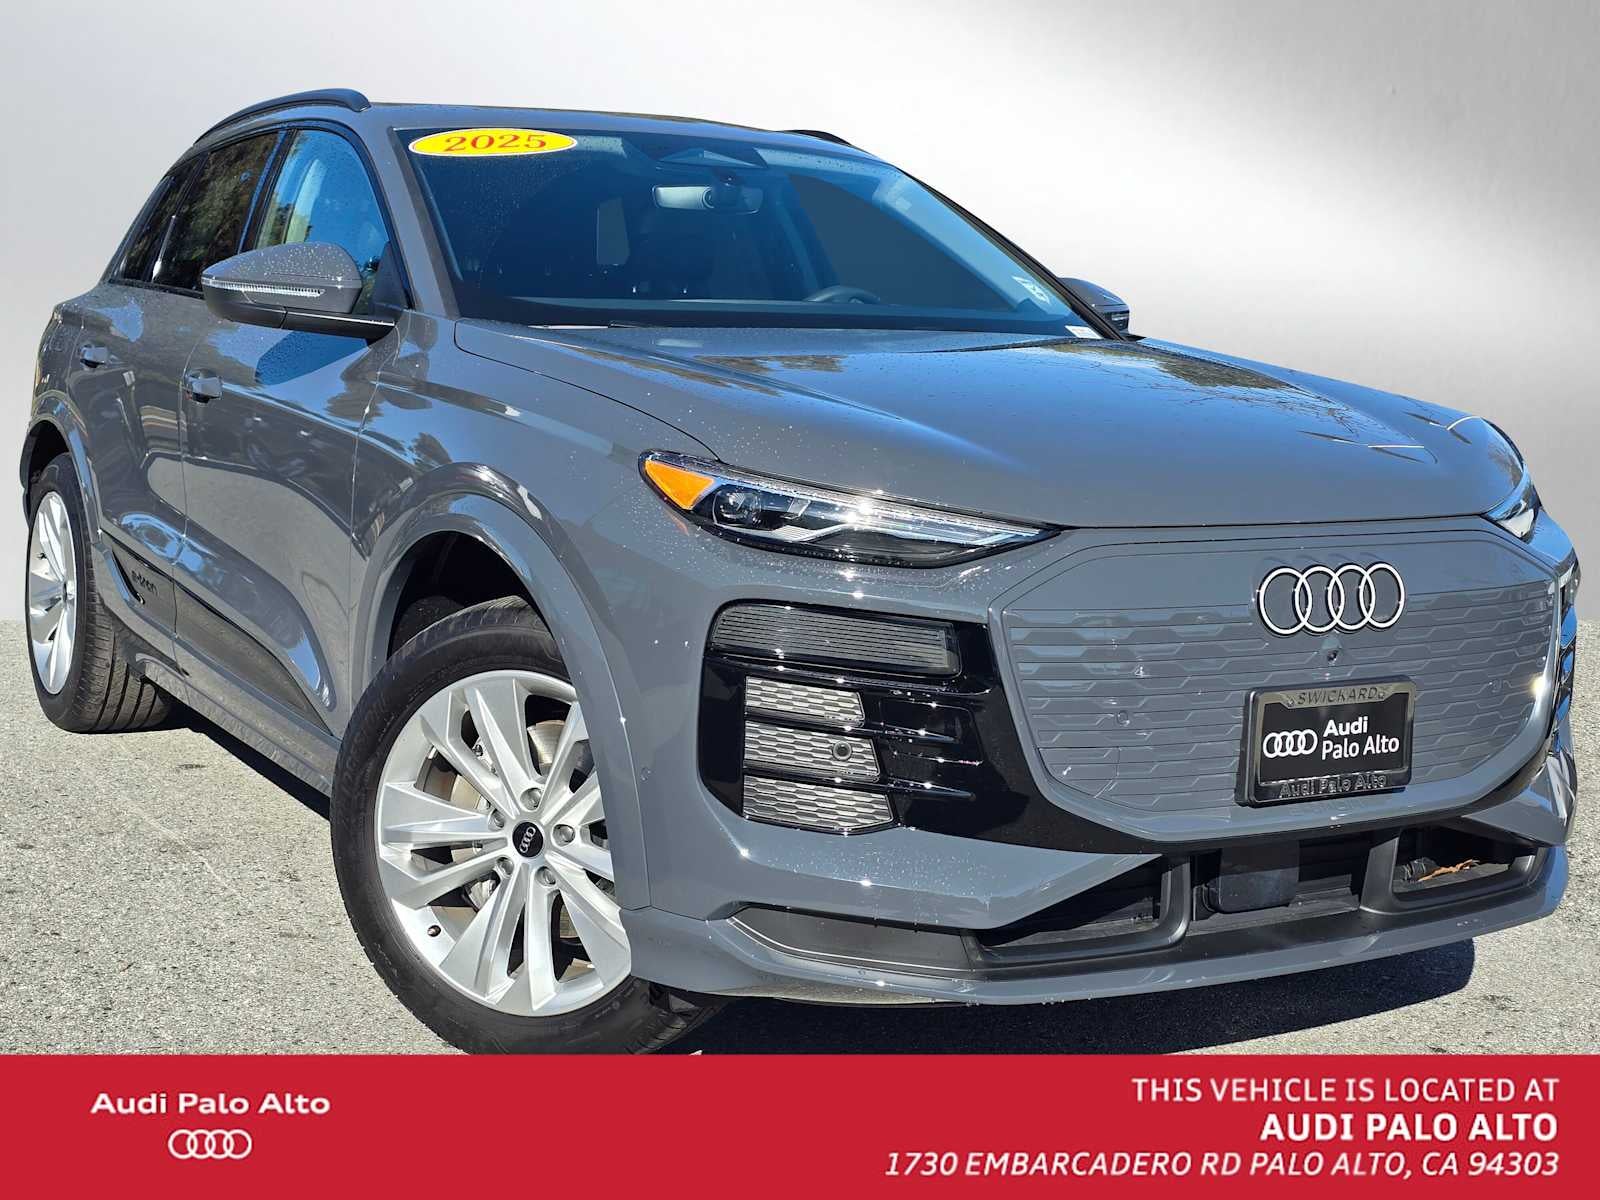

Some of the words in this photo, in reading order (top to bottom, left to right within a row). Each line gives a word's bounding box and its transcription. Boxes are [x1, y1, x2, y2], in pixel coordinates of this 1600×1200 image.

[444, 134, 547, 152] 2025
[1297, 686, 1379, 706] SWICKARD
[1322, 716, 1369, 737] Audi
[1321, 740, 1360, 760] Palo
[1363, 734, 1400, 756] Alto
[1279, 780, 1315, 799] Audi
[1319, 777, 1351, 794] Palo
[1354, 773, 1387, 790] Alto
